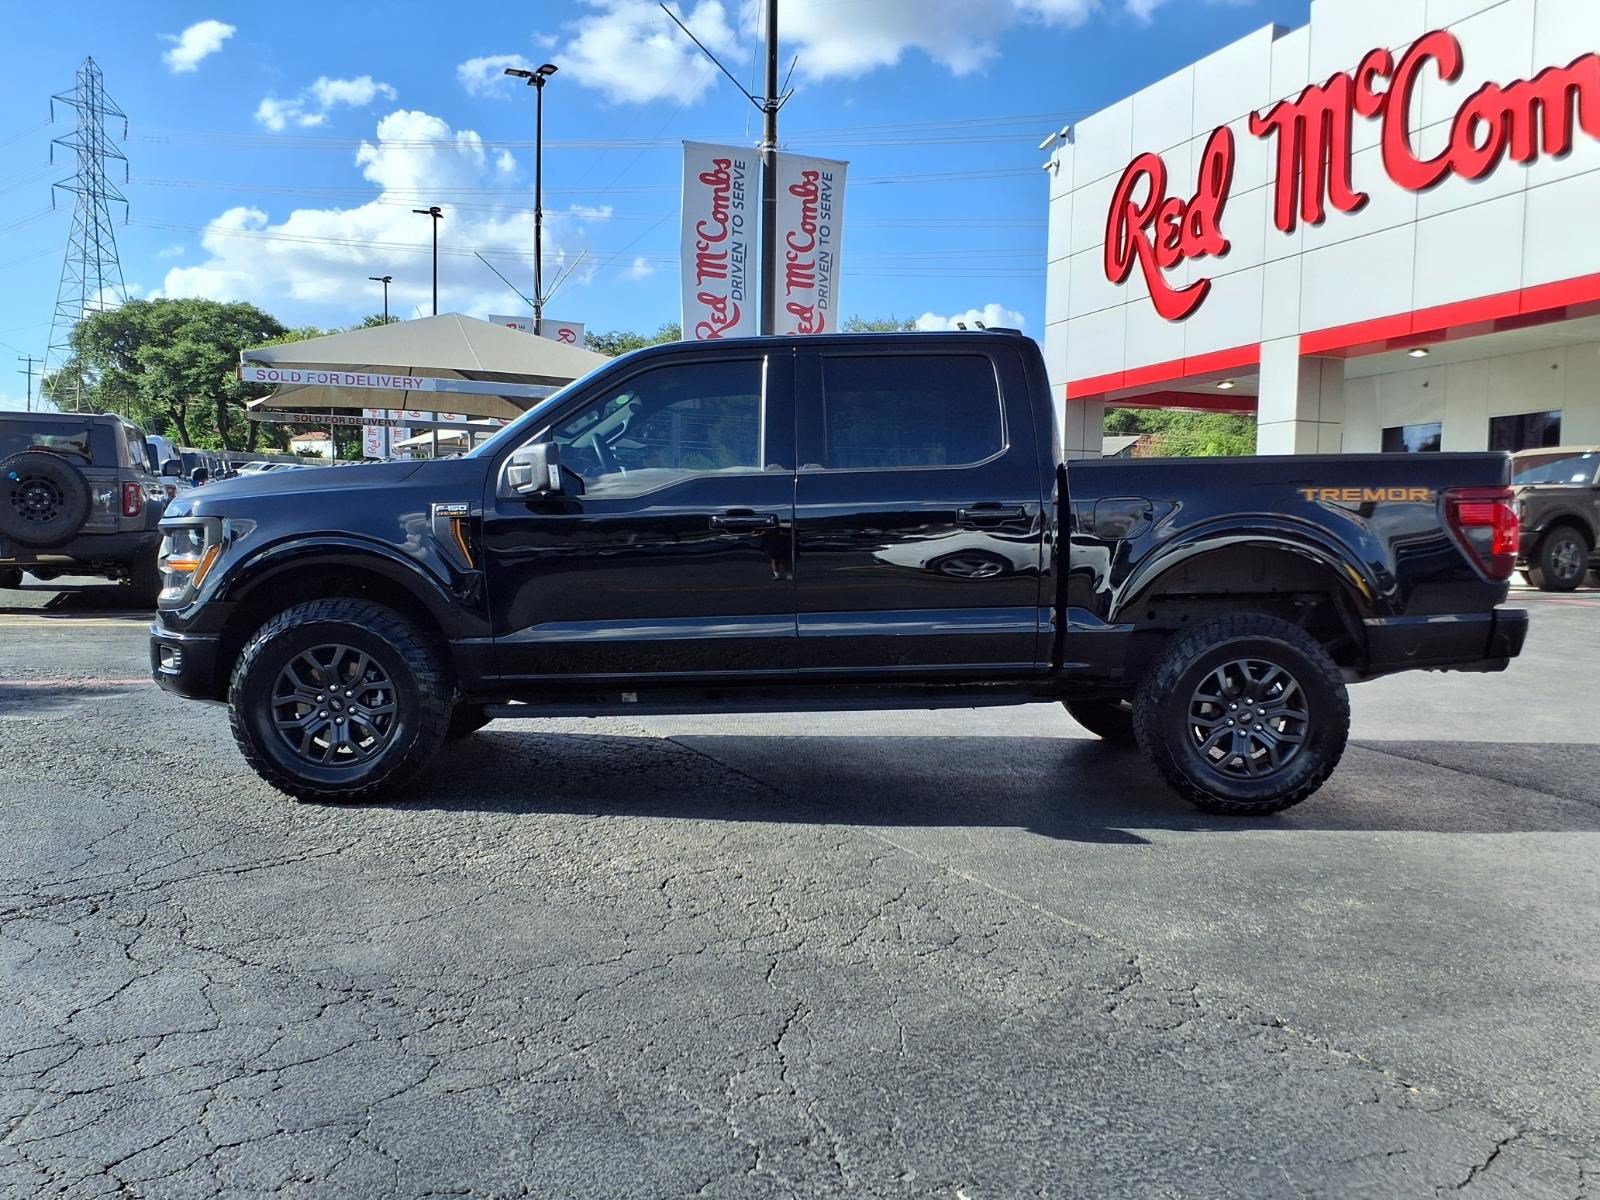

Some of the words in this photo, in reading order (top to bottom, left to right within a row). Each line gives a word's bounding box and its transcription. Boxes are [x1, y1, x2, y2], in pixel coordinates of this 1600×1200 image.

[733, 159, 746, 210] SERVE
[820, 172, 833, 221] SERVE
[695, 158, 732, 287] McCombs
[732, 216, 744, 236] TO
[786, 170, 820, 296] McCombs
[819, 226, 831, 246] TO
[1104, 125, 1235, 321] Red
[731, 242, 744, 301] DRIVEN
[818, 251, 829, 310] DRIVEN
[695, 292, 740, 339] Red
[786, 302, 824, 334] ed
[256, 369, 301, 383] SOLD
[307, 372, 340, 385] FOR
[345, 375, 424, 389] DELIVERY
[294, 414, 321, 423] SOLD
[325, 416, 346, 425] FOR
[348, 417, 399, 427] DELIVERY
[1299, 487, 1431, 502] TREMOR
